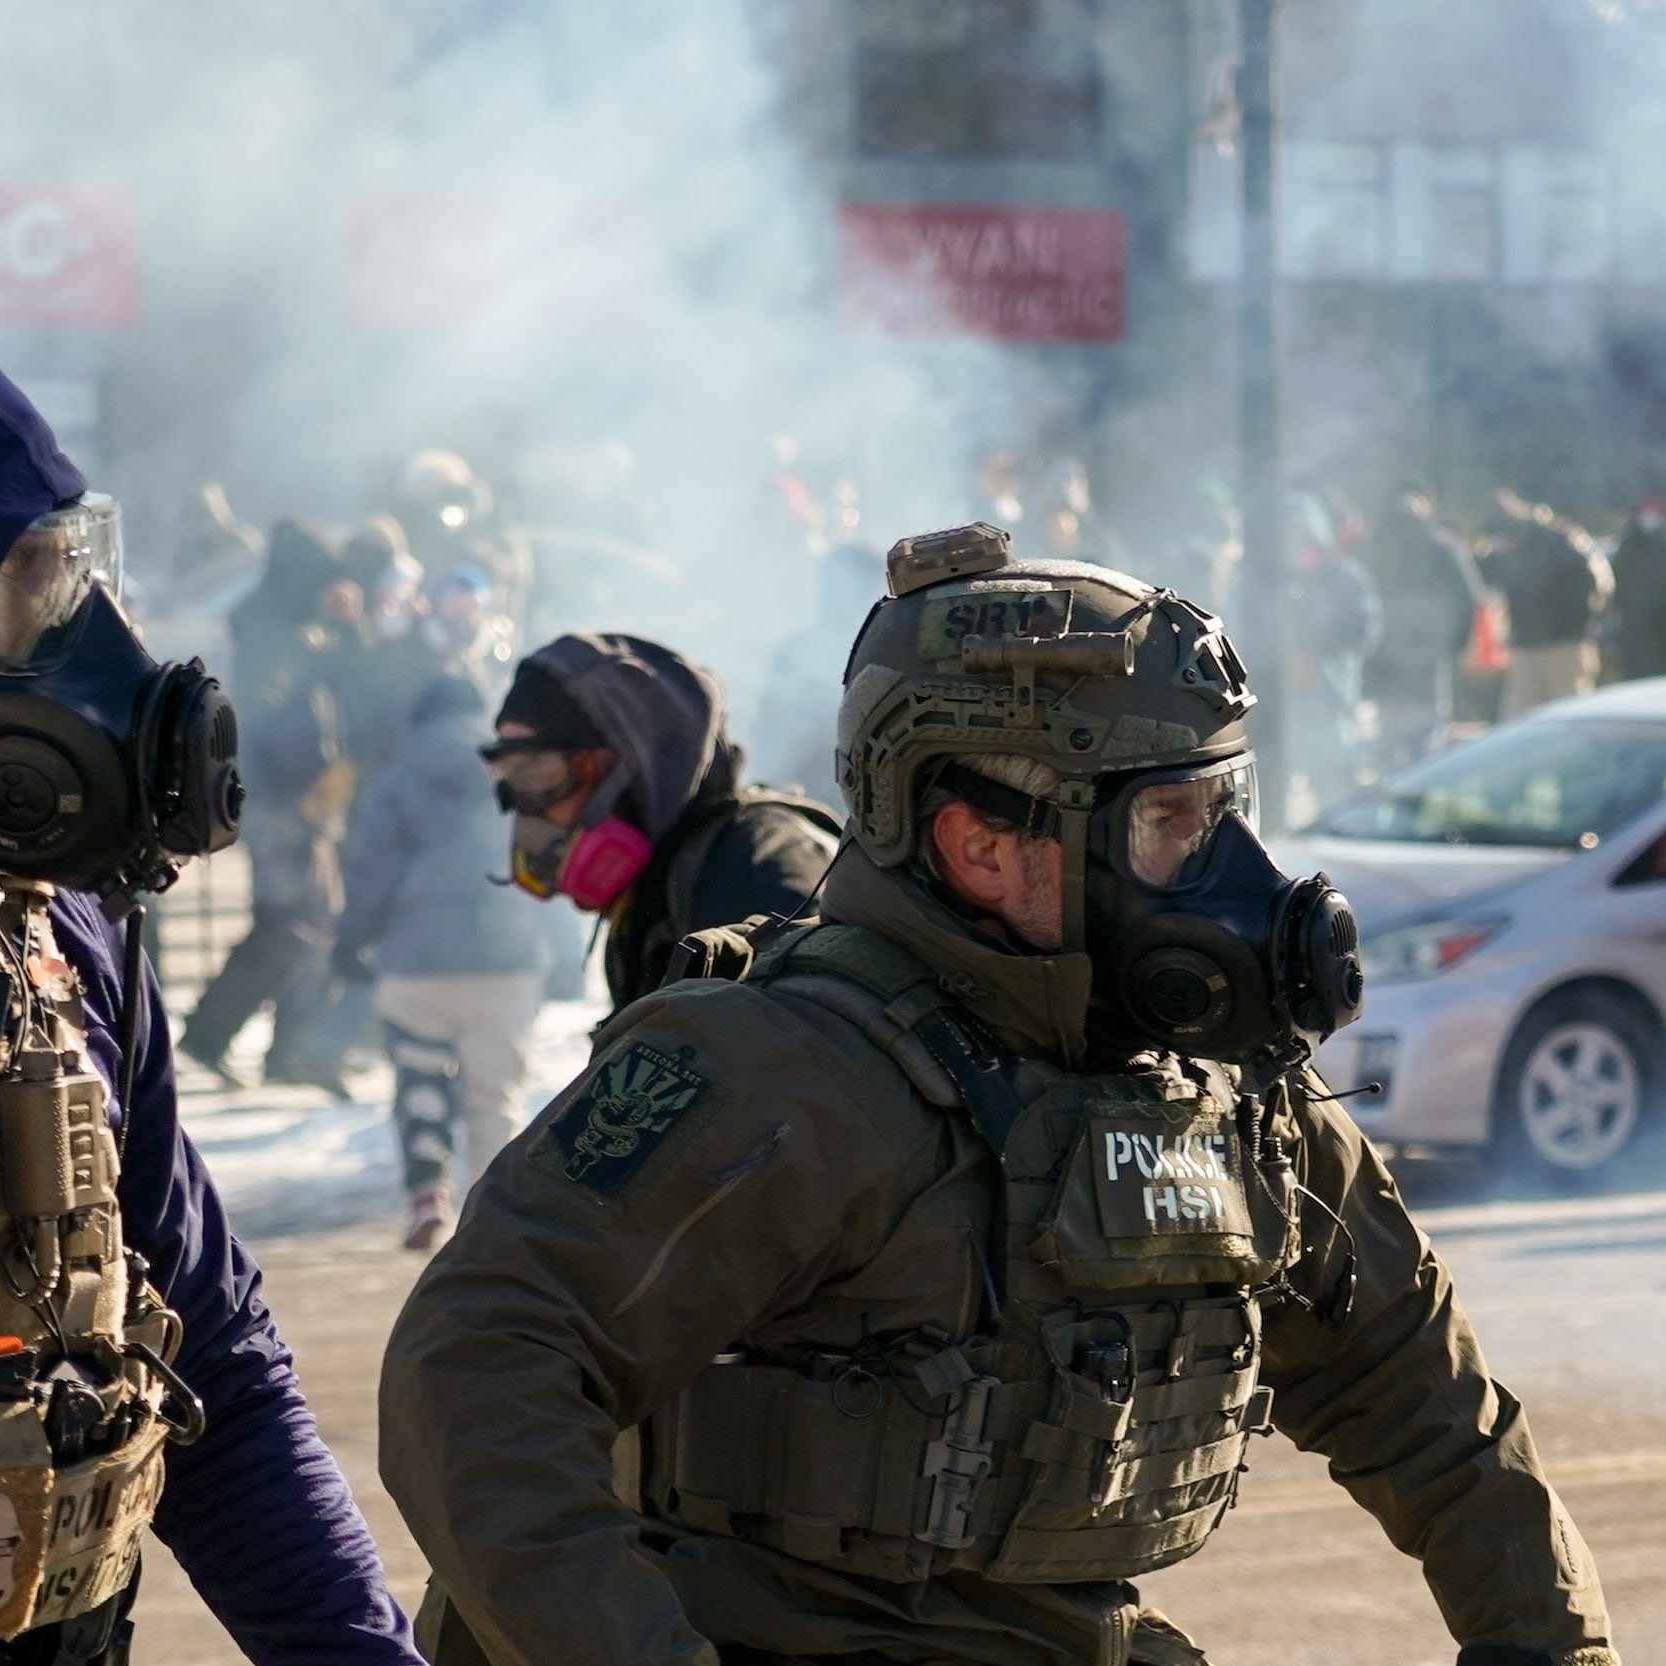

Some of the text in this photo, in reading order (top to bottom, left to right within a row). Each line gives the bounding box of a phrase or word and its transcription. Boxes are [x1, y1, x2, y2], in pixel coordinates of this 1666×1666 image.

[636, 1044, 679, 1074] ARIZONA
[1105, 1131, 1231, 1182] POLICE
[1143, 1185, 1226, 1220] HSI
